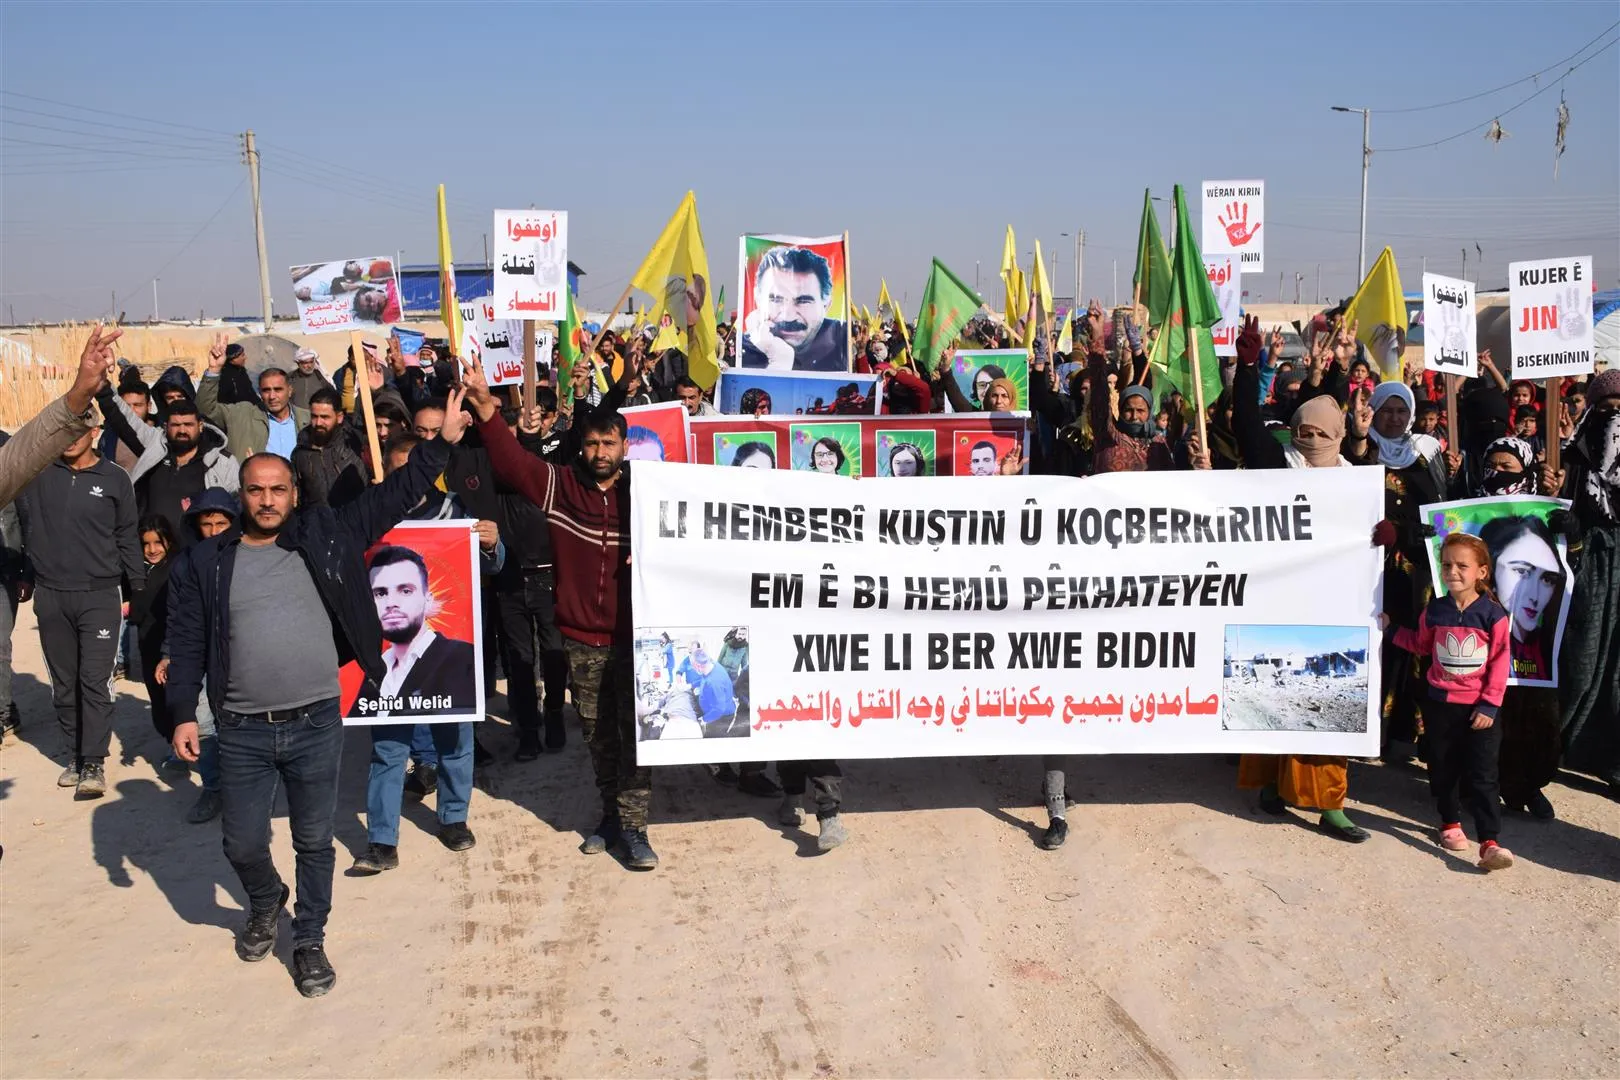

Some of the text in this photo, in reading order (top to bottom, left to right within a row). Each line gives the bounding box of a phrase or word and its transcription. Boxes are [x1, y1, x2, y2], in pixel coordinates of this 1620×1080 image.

[1206, 186, 1261, 198] WÊRAN KIRIN
[507, 213, 557, 243] أوقفوا
[501, 253, 535, 276] قتلة
[1519, 262, 1583, 287] KUJER Ê
[507, 289, 556, 313] النساء
[1432, 283, 1469, 310] أوقفوا
[1518, 304, 1558, 333] JIN
[484, 330, 510, 350] قتلة
[1434, 346, 1469, 368] القتل
[658, 500, 688, 539] LI
[878, 508, 1006, 552] KUŞTIN
[1020, 498, 1042, 546] Û
[750, 561, 1248, 611] EM Ê BI HEMÛ PÊKHATEYÊN
[792, 631, 1197, 673] XWE LI BER XWE BIDIN
[358, 694, 452, 715] Şehîd Welîd
[752, 685, 1219, 733] صامدون بجميع مكوناتنا في وجه القتل والتهجير
